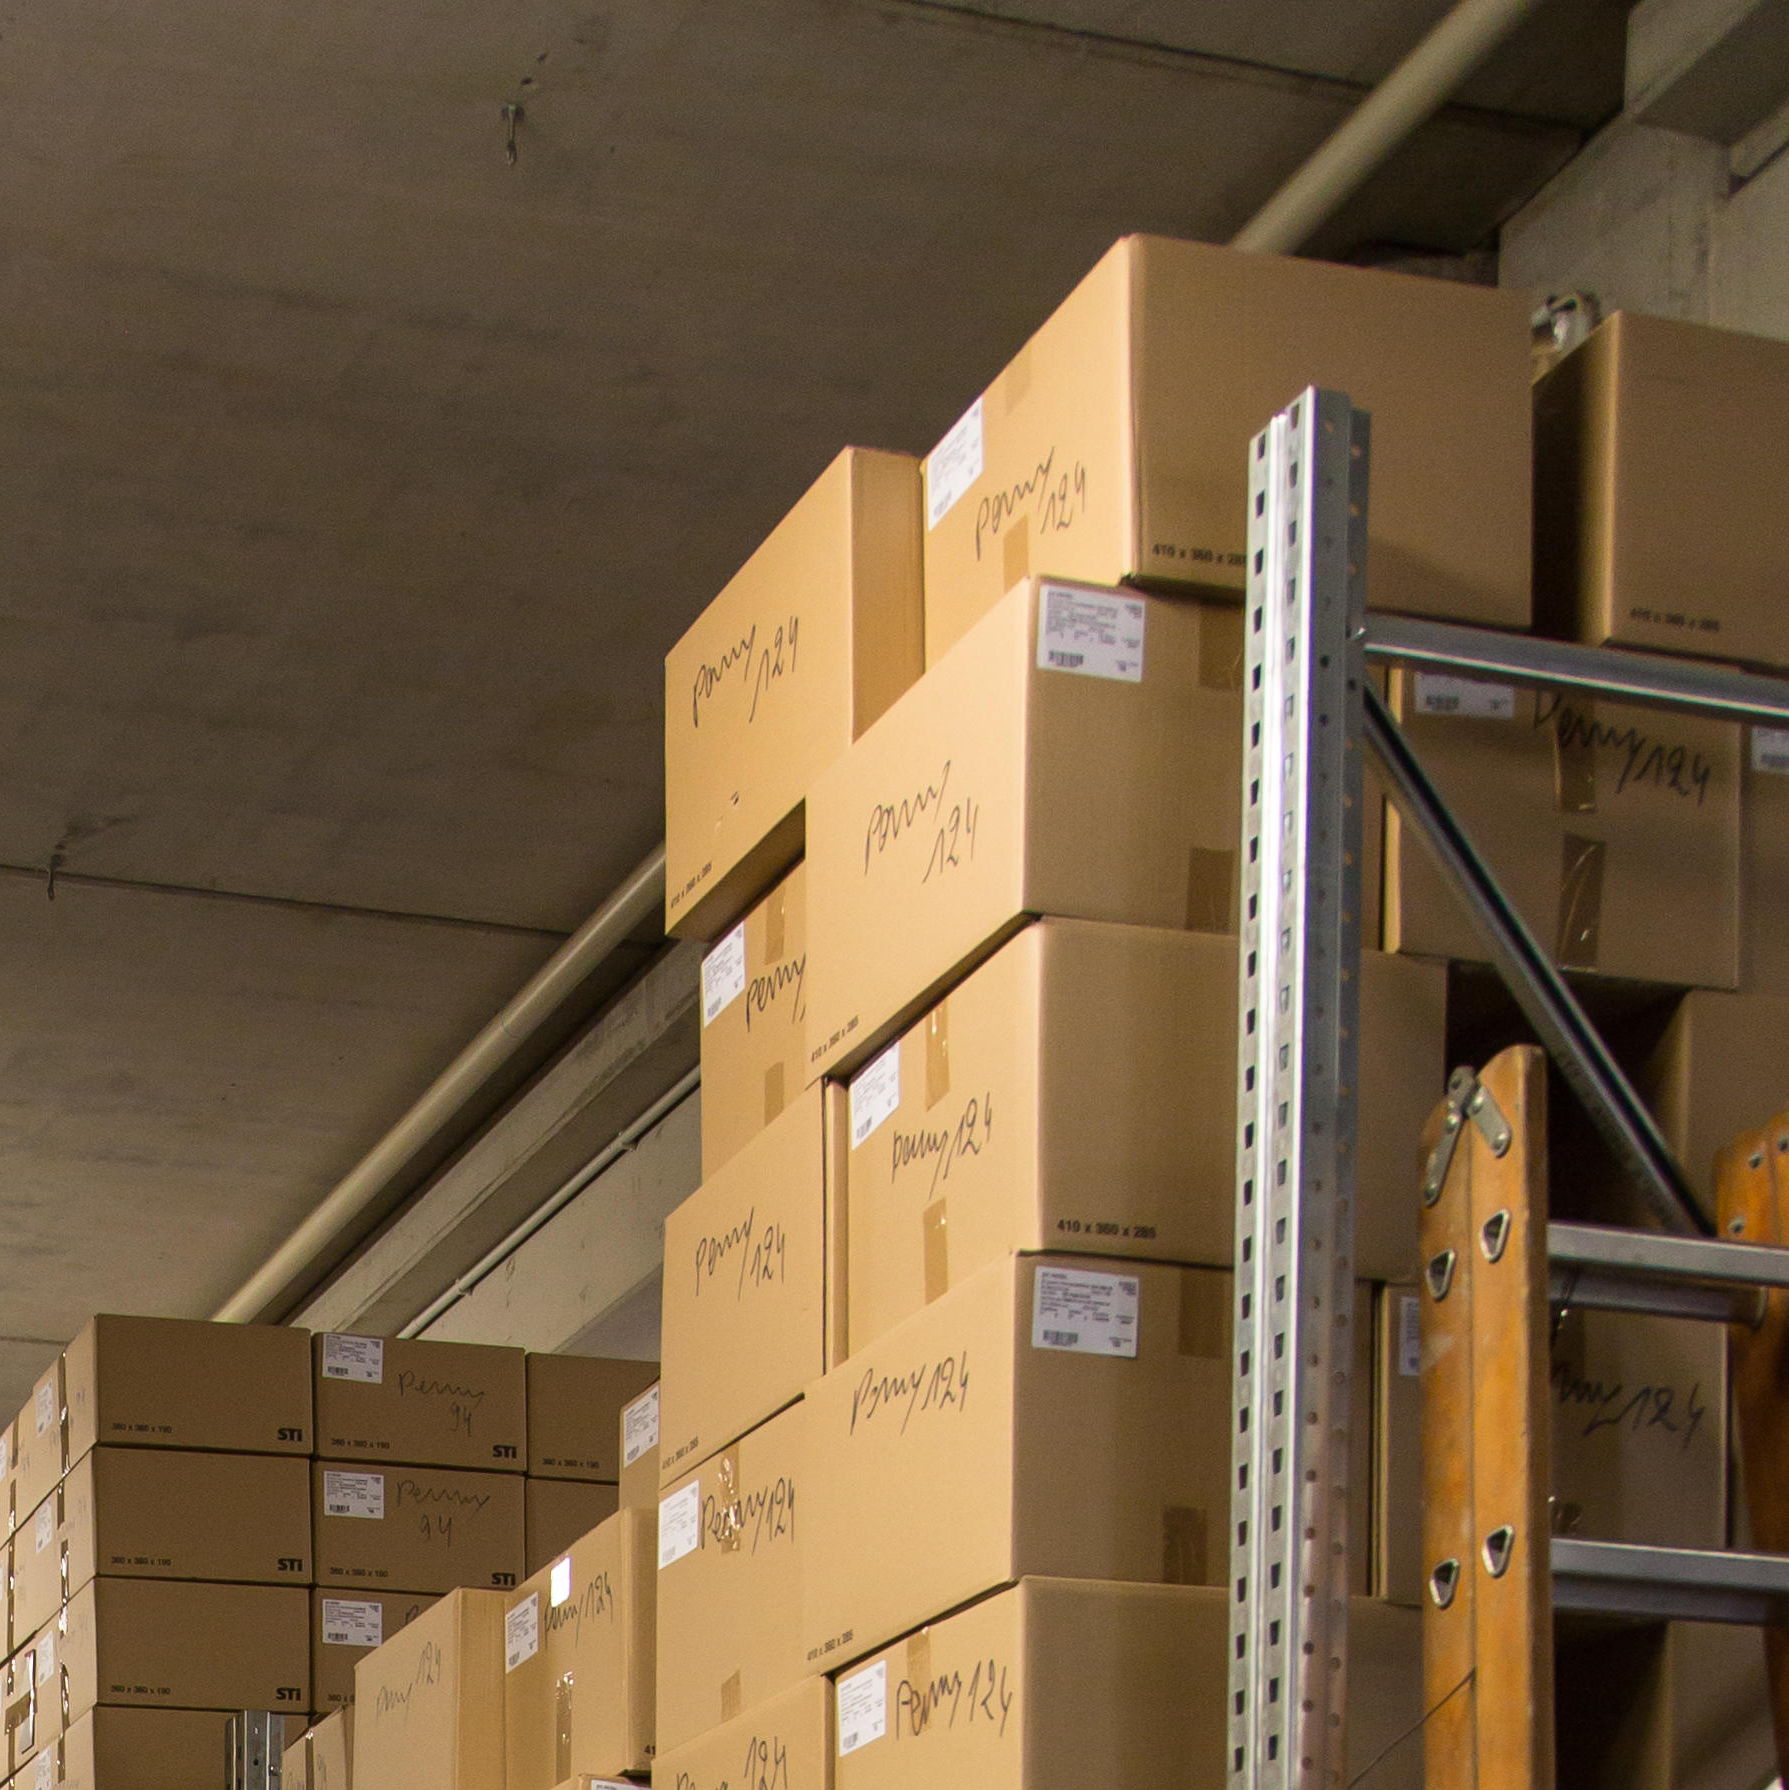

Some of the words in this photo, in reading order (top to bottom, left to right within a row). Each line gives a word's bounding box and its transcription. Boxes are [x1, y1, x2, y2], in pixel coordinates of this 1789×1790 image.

[1040, 460, 1086, 535] 124
[749, 615, 799, 724] 124
[922, 797, 979, 884] 124
[750, 1219, 786, 1288] 124
